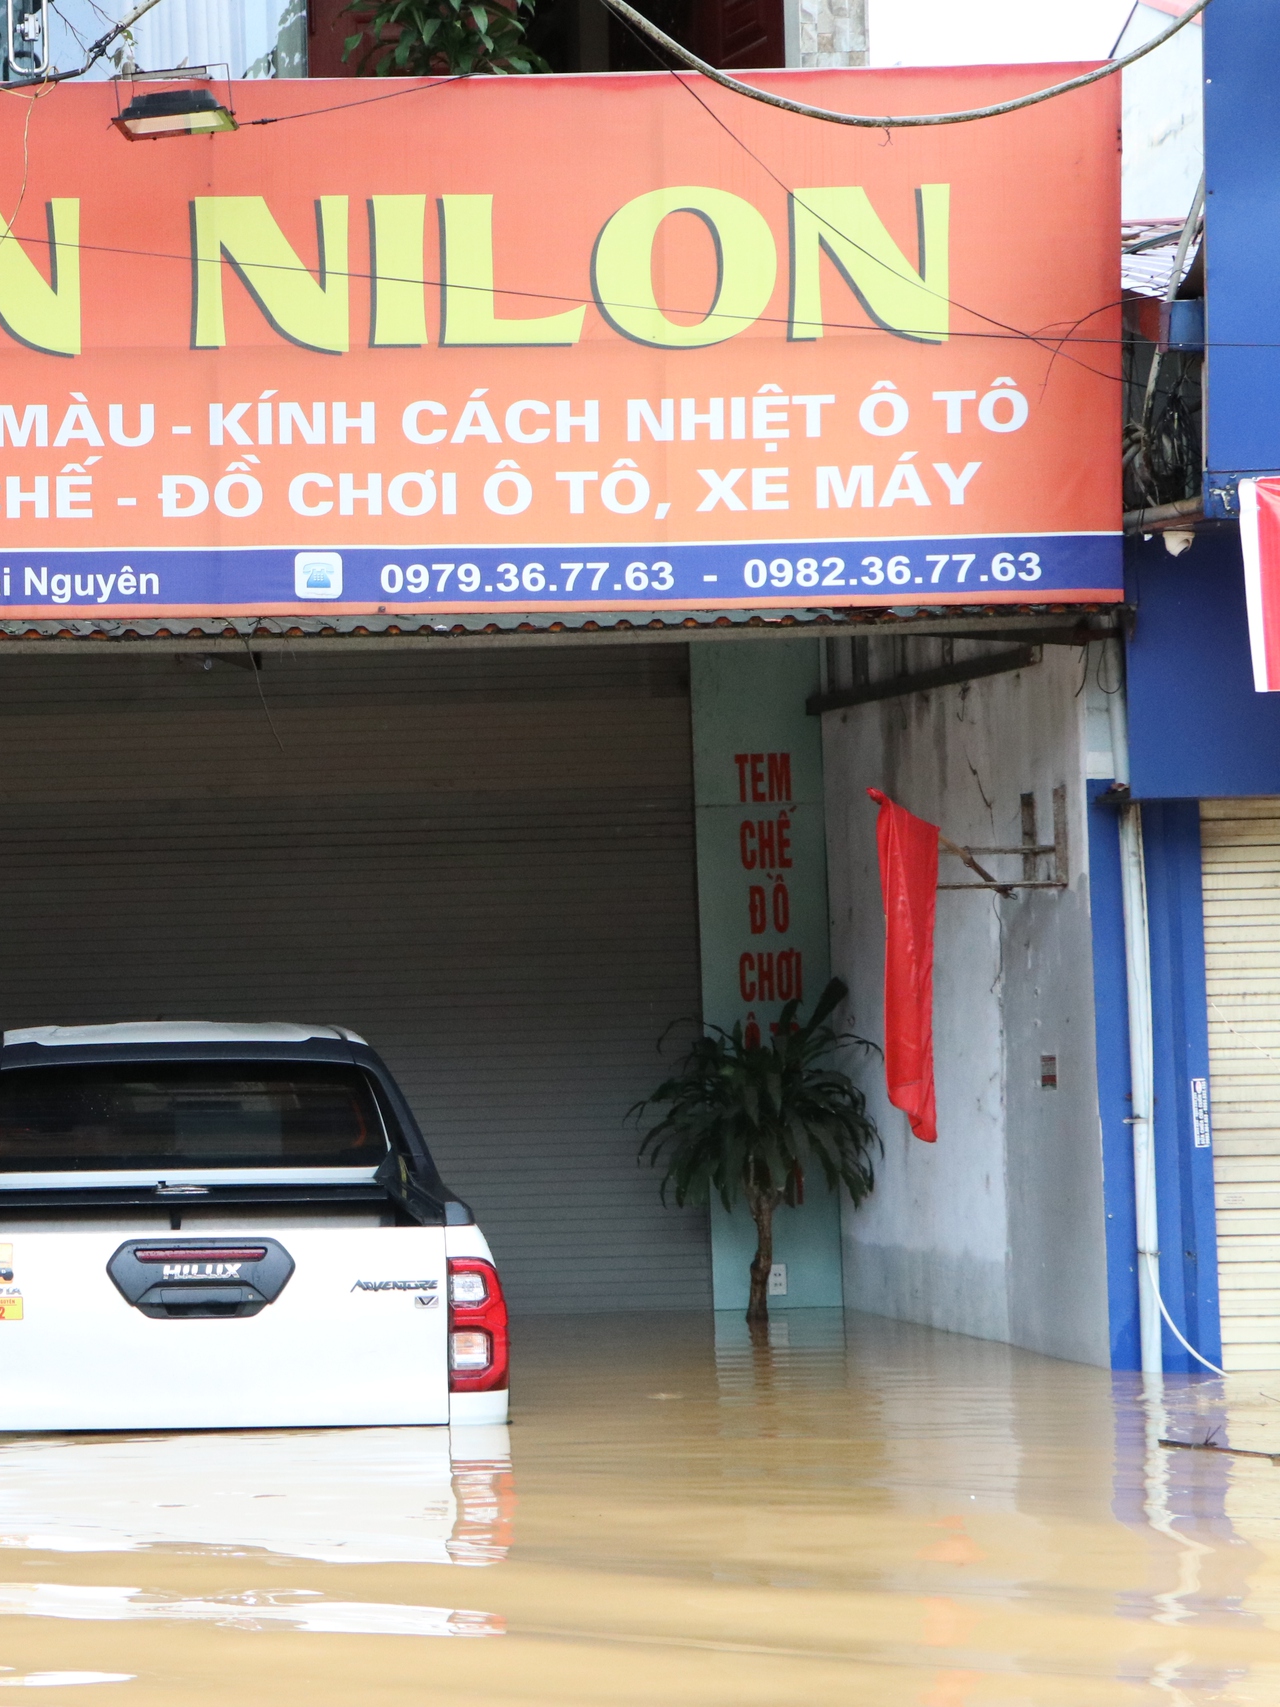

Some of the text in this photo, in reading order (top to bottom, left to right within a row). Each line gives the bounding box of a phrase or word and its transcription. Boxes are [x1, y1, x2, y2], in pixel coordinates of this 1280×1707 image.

[188, 183, 950, 355] NILON
[210, 389, 376, 444] KÍNH
[402, 388, 600, 444] CÁCH
[627, 384, 836, 452] NHIỆT
[858, 380, 909, 436] Ô
[932, 376, 1029, 434] TÔ
[158, 454, 263, 517] ĐỒ
[289, 470, 457, 516] CHƠI
[484, 459, 533, 515] Ô
[556, 457, 671, 519] TÔ,
[696, 467, 790, 512] XE
[816, 451, 982, 509] MÁY
[24, 565, 159, 604] Nguyên
[380, 562, 675, 594] 0979.36.77.63
[743, 552, 1042, 588] 0982.36.77.63
[734, 753, 792, 802] TEM
[740, 806, 797, 870] CHẾ
[749, 873, 790, 934] ĐỒ
[739, 947, 802, 1001] CHƠI
[163, 1263, 242, 1280] HILUX
[350, 1279, 439, 1293] ADVENTURE
